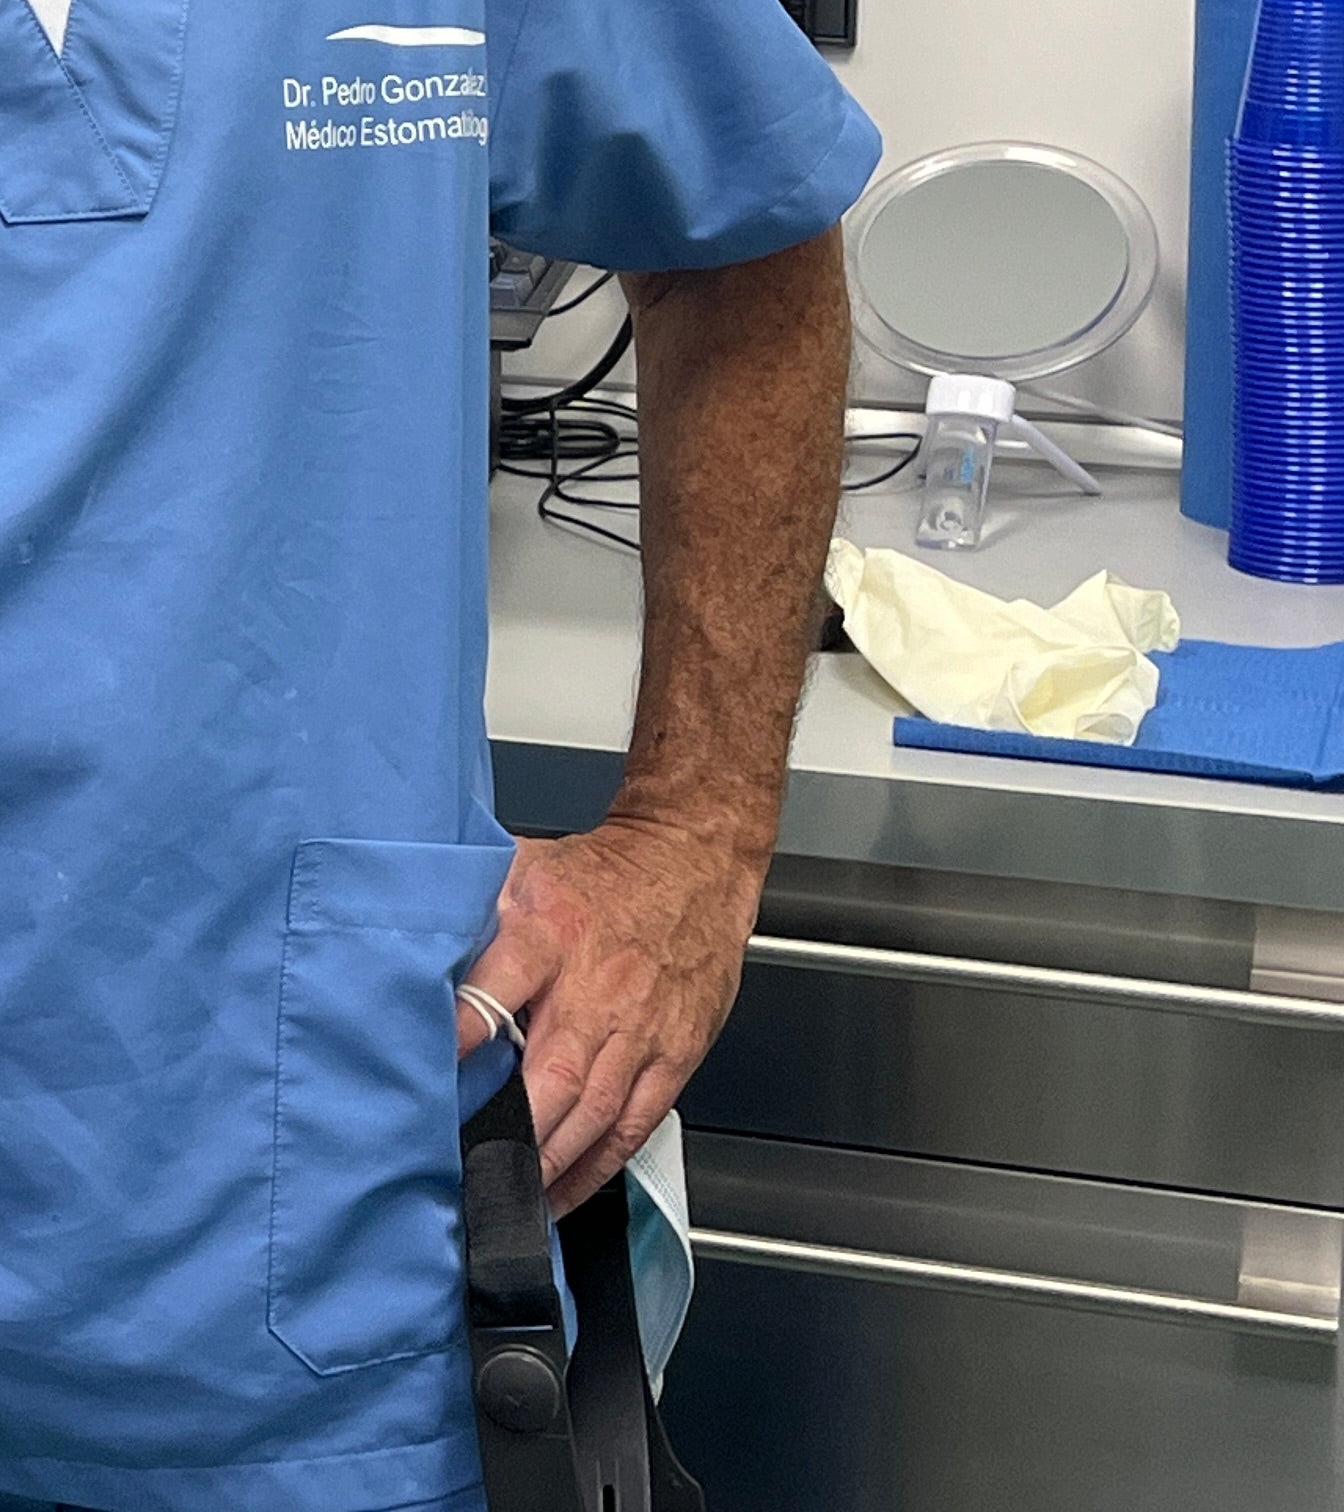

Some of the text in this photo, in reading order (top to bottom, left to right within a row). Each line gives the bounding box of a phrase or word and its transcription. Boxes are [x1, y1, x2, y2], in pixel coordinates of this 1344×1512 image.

[282, 78, 317, 108] Dr.
[321, 75, 376, 106] Pedro
[285, 118, 357, 151] Médico
